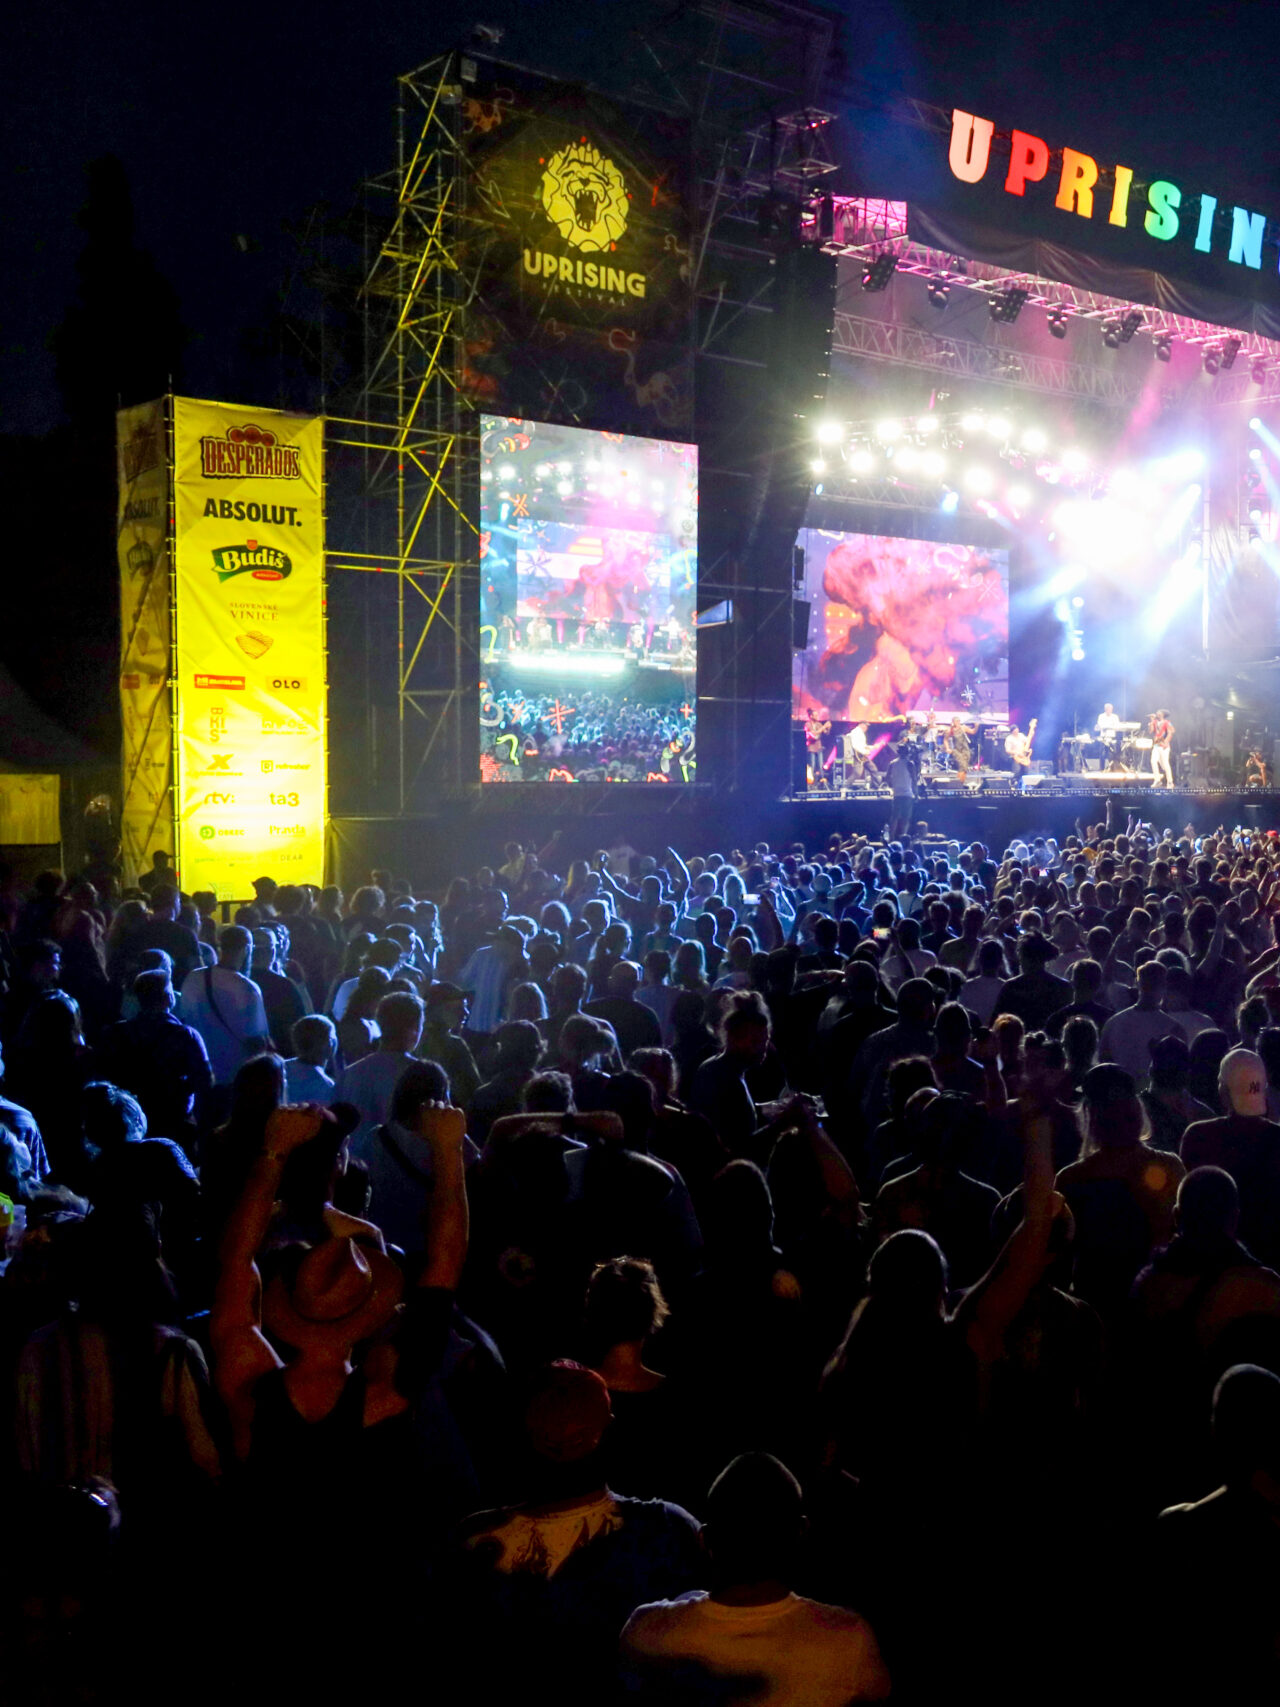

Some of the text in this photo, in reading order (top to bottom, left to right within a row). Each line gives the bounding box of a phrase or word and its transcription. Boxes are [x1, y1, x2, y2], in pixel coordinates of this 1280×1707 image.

[523, 248, 646, 298] UPRISING
[205, 439, 299, 477] DESPERADOS
[203, 498, 302, 527] ABSOLUT.
[214, 548, 286, 573] Budiš
[230, 610, 280, 621] VINICE
[272, 679, 301, 689] OLO
[269, 792, 300, 807] ta3
